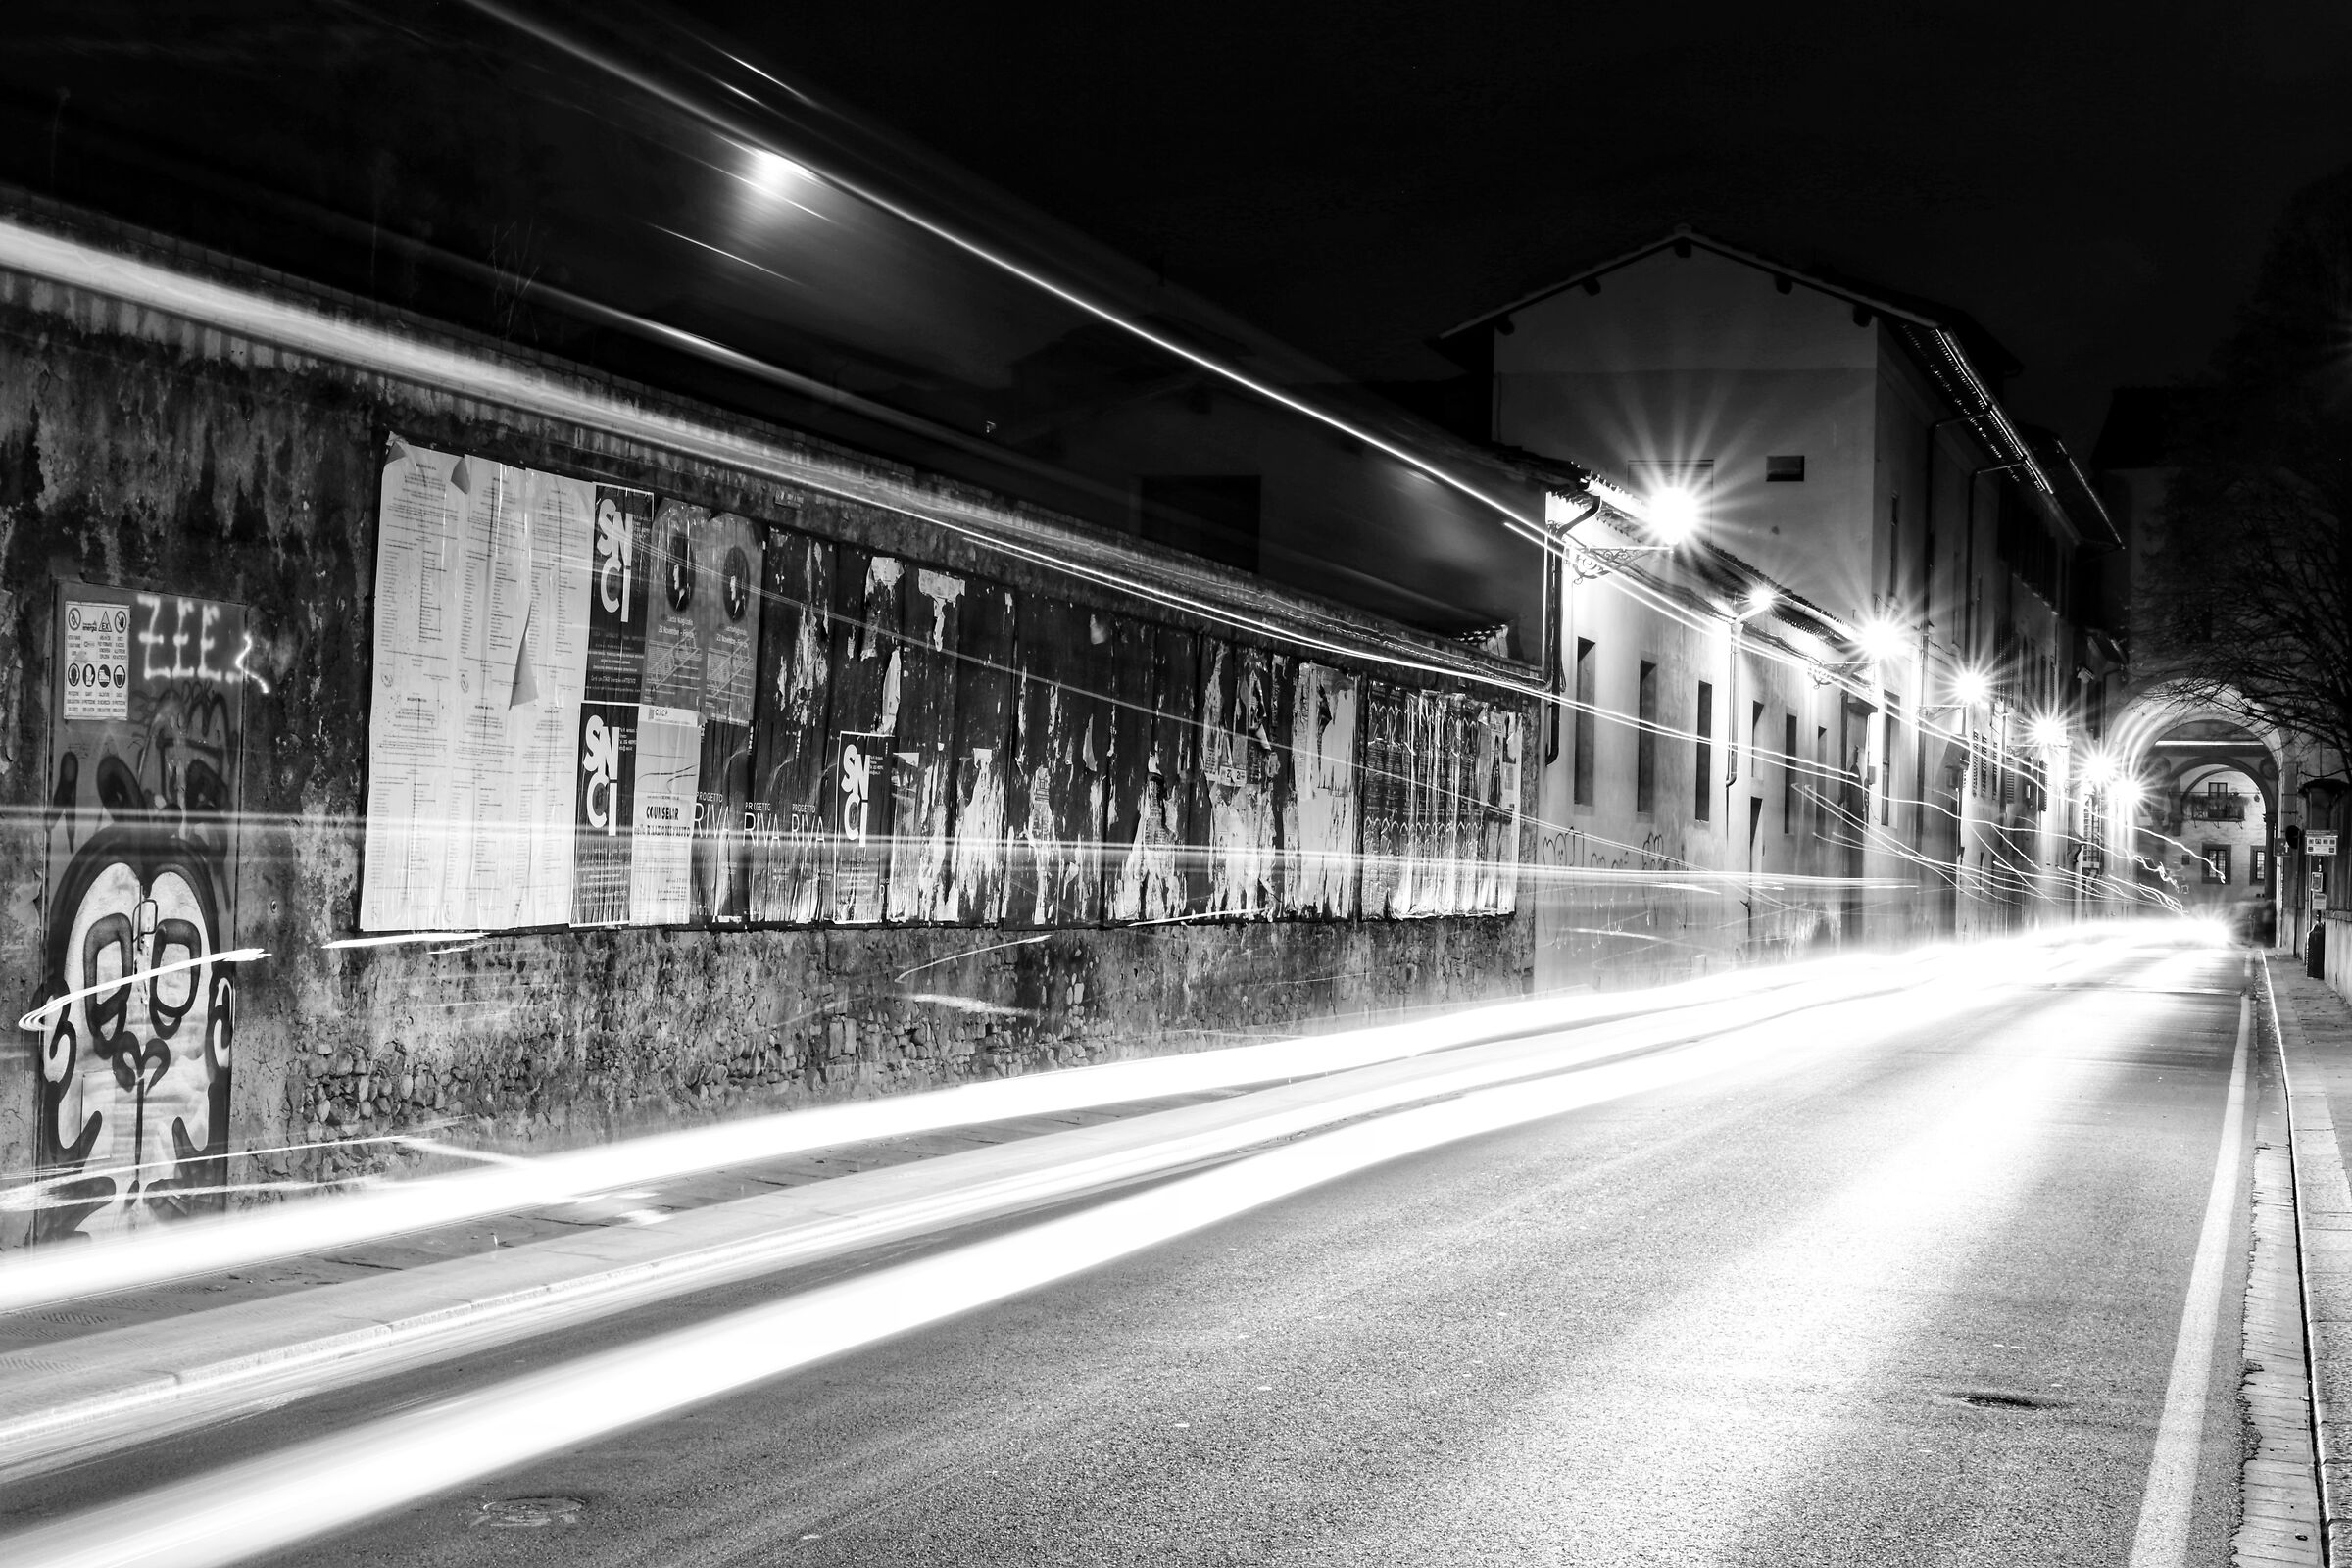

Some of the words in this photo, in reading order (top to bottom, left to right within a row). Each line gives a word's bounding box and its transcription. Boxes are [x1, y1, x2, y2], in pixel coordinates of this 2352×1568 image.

[696, 792, 723, 803] PROGETTO
[745, 802, 771, 812] PROGETTO
[792, 803, 816, 814] PROGETTO
[694, 802, 730, 839] RIVA
[742, 812, 781, 847] RIVA
[791, 813, 826, 849] RIVA
